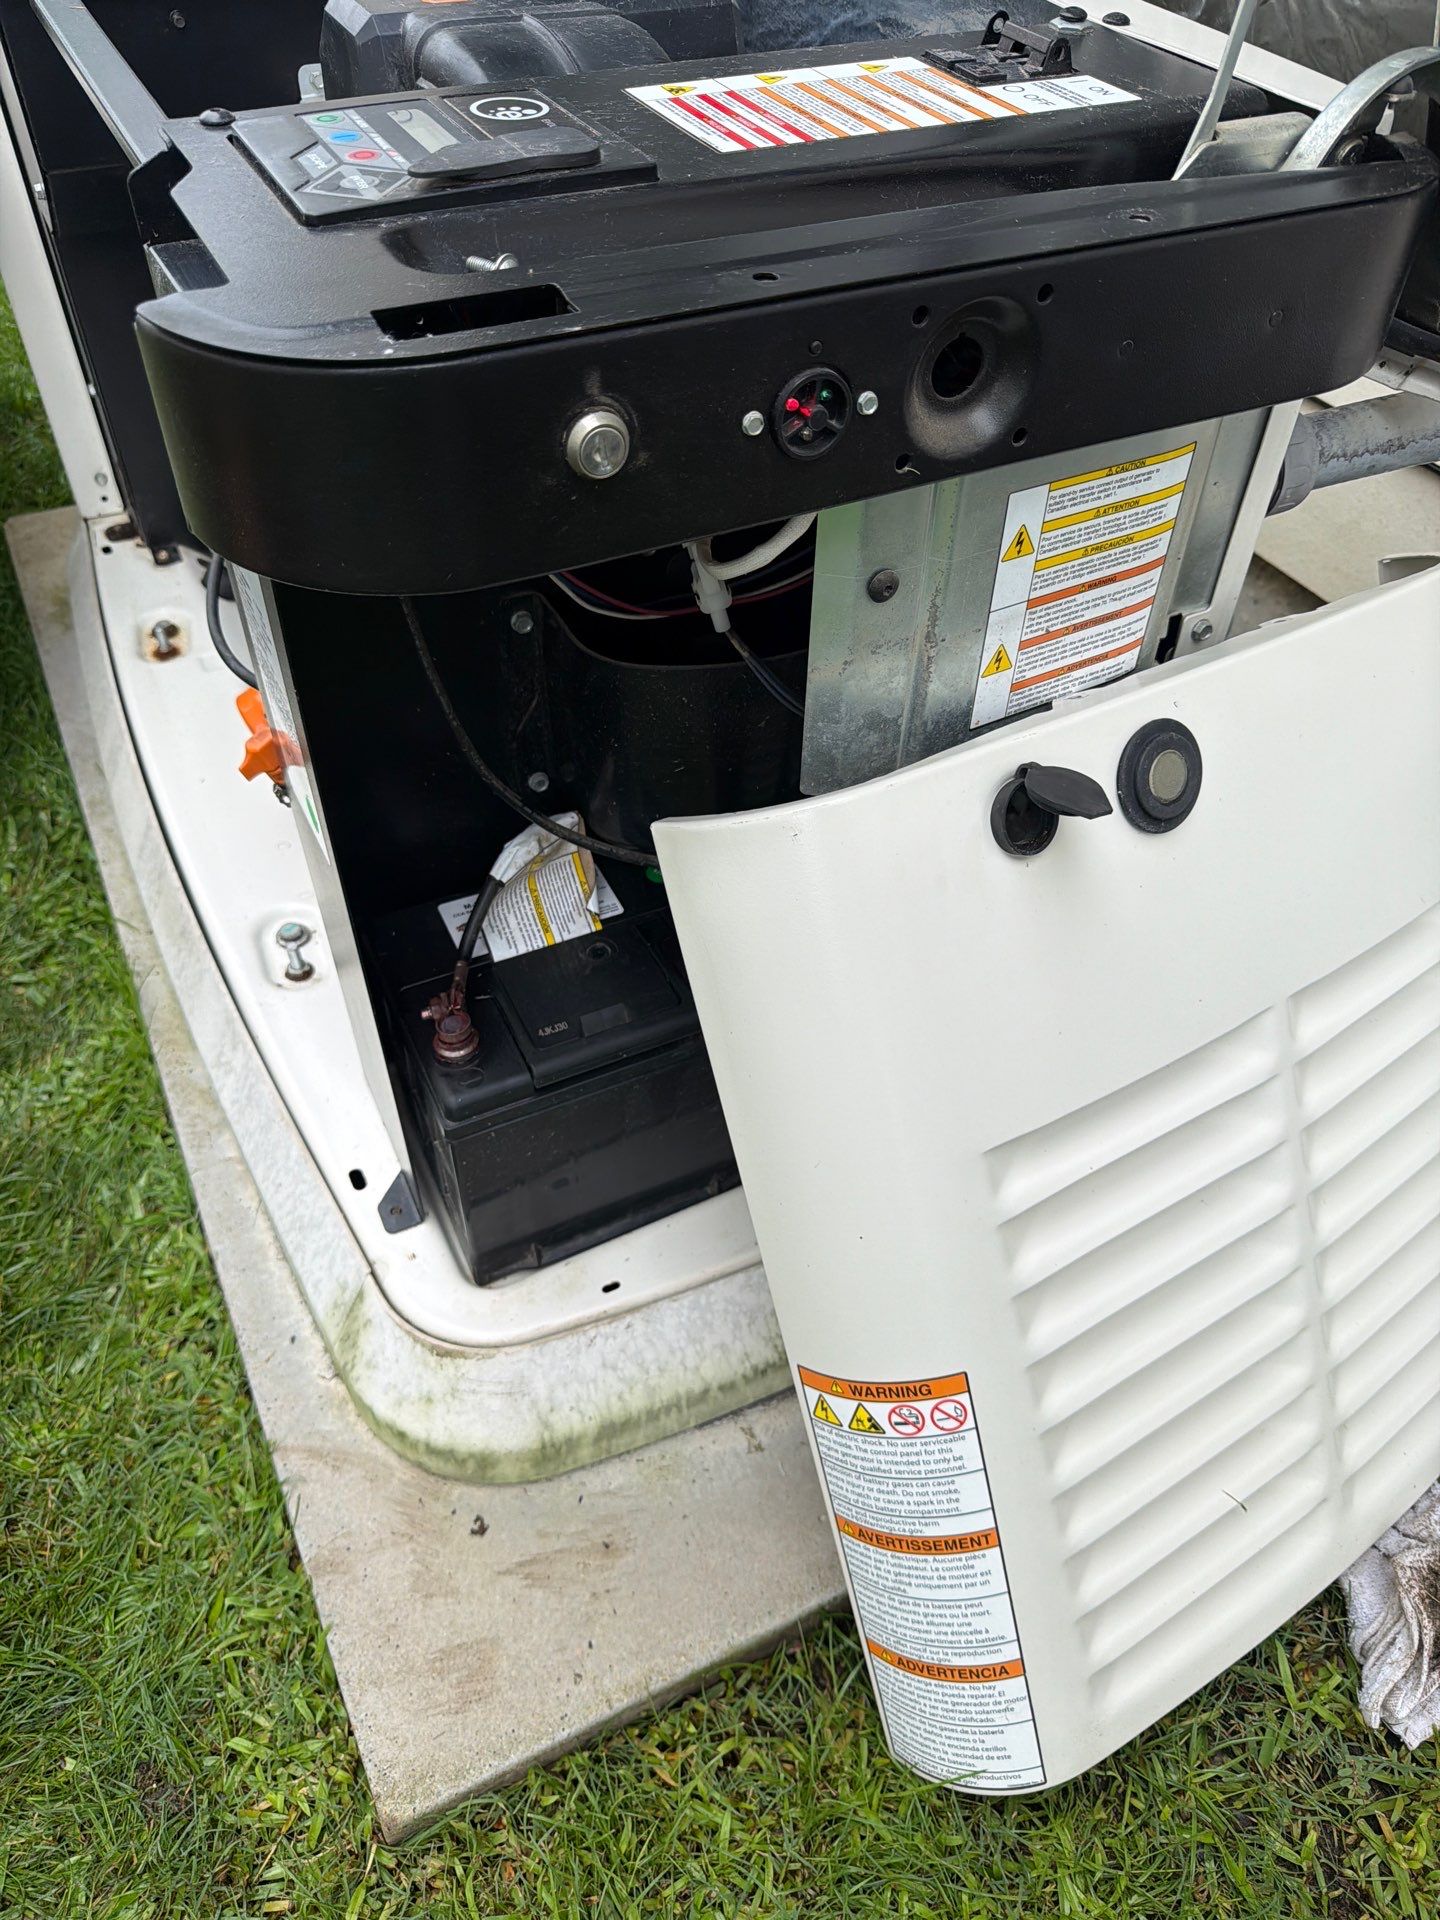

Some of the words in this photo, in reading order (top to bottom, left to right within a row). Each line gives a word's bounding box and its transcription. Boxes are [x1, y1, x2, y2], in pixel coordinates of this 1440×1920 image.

[1089, 86, 1115, 96] ON
[1023, 94, 1056, 106] OFF
[1115, 460, 1146, 474] CAUTION
[1133, 469, 1155, 480] generator
[1102, 499, 1140, 514] ATTENTION
[1089, 535, 1135, 553] PRECAUCIÓN
[1087, 576, 1117, 590] WARNING
[848, 1384, 932, 1399] WARNING
[861, 1437, 885, 1447] shock.
[920, 1434, 966, 1447] serviceable
[854, 1444, 868, 1453] The
[900, 1449, 923, 1458] panel
[924, 1448, 936, 1456] for
[937, 1446, 953, 1455] this
[933, 1456, 951, 1465] only
[952, 1454, 964, 1462] be
[859, 1464, 892, 1475] qualified
[924, 1463, 967, 1476] personnel.
[862, 1474, 889, 1488] battery
[891, 1481, 914, 1489] gases
[931, 1478, 956, 1487] cause
[901, 1489, 914, 1497] Do
[882, 1497, 905, 1506] cause
[913, 1498, 935, 1507] spark
[945, 1496, 960, 1505] the
[874, 1503, 902, 1515] battery
[903, 1506, 962, 1516] compartment.
[868, 1514, 917, 1527] reproductive
[858, 1528, 991, 1551] AVERTISSEMENT
[932, 1556, 963, 1564] Aucune
[964, 1552, 987, 1563] pièce
[941, 1562, 976, 1572] contrôle
[948, 1572, 978, 1580] moteur
[979, 1569, 992, 1577] est
[914, 1581, 963, 1590] uniquement
[979, 1578, 991, 1586] un
[931, 1601, 963, 1610] batterie
[964, 1601, 984, 1611] peut
[960, 1610, 969, 1618] la
[970, 1608, 992, 1618] mort.
[974, 1634, 1008, 1645] batterie.
[950, 1647, 1003, 1657] reproduction
[897, 1657, 1010, 1679] ADVERTENCIA
[982, 1684, 997, 1692] hay
[950, 1699, 991, 1707] generador
[1003, 1695, 1027, 1705] motor
[967, 1692, 997, 1701] reparar.
[940, 1705, 974, 1715] operado
[974, 1706, 1016, 1715] solamente
[957, 1714, 996, 1723] calificado.
